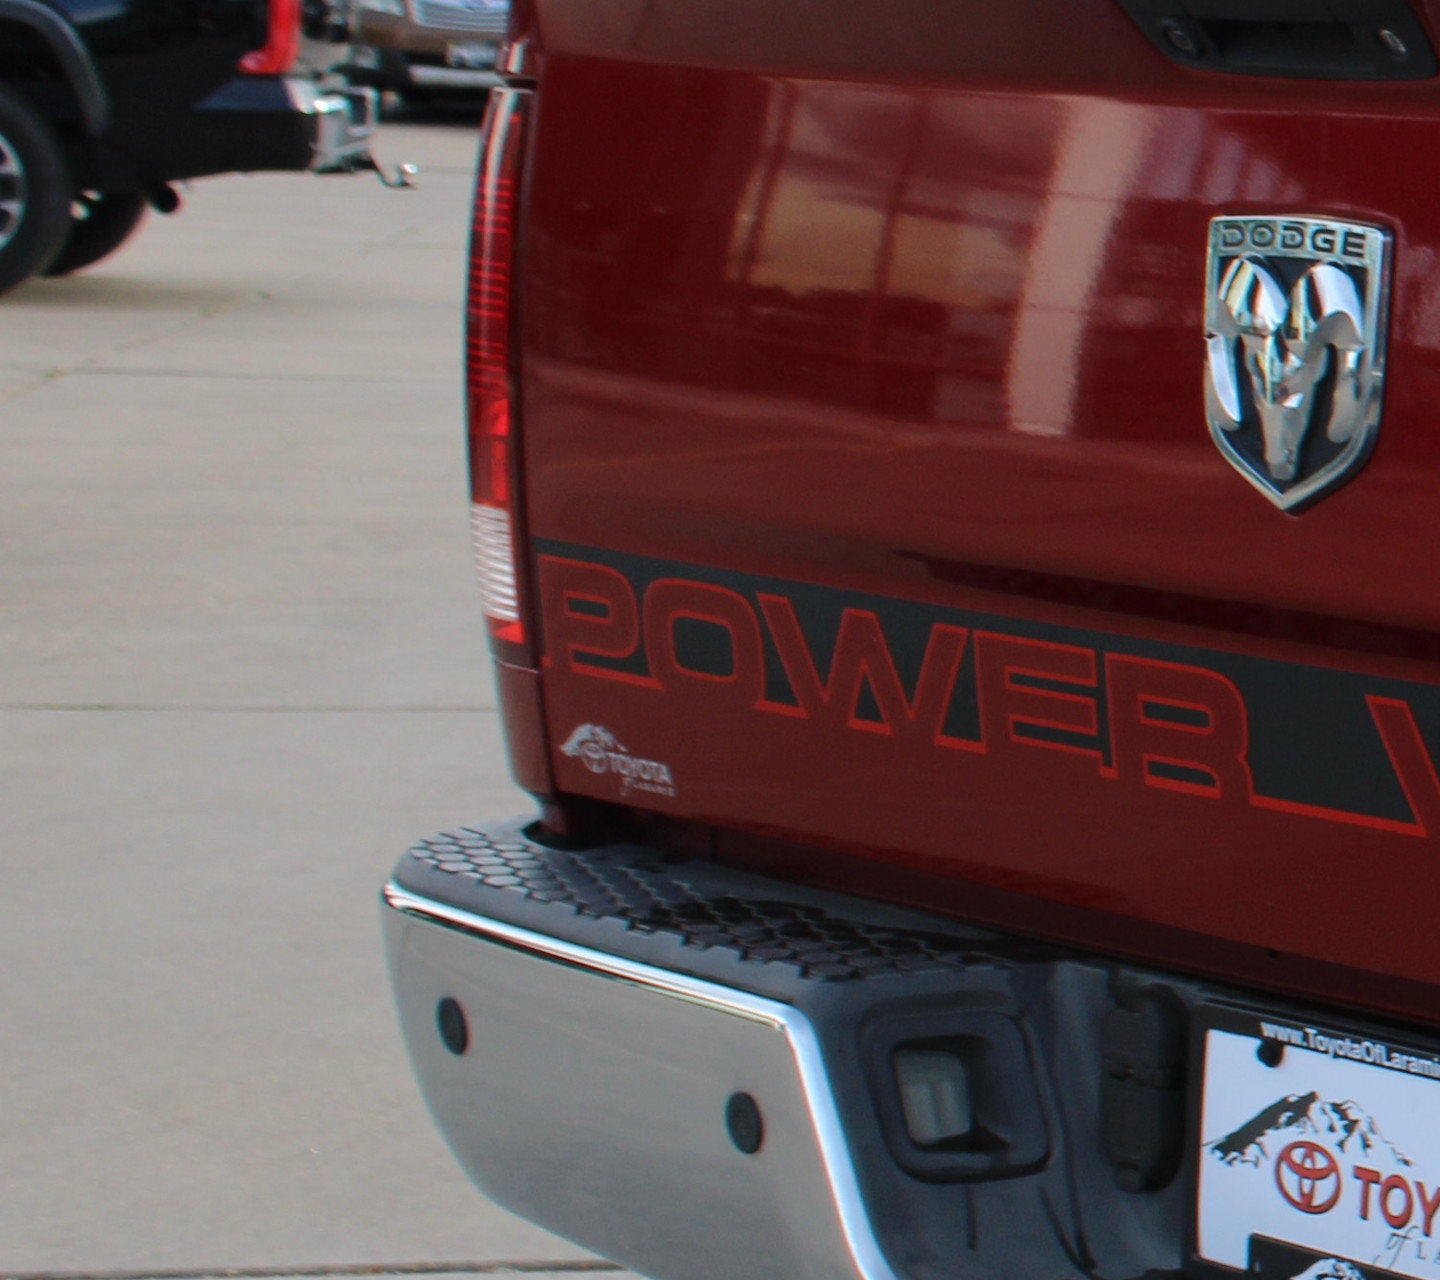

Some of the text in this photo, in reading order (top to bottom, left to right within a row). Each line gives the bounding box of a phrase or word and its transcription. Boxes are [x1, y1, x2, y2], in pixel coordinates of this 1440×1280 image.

[1220, 223, 1367, 260] DODGE
[537, 553, 1256, 801] POWER
[606, 751, 675, 785] TOYOTA
